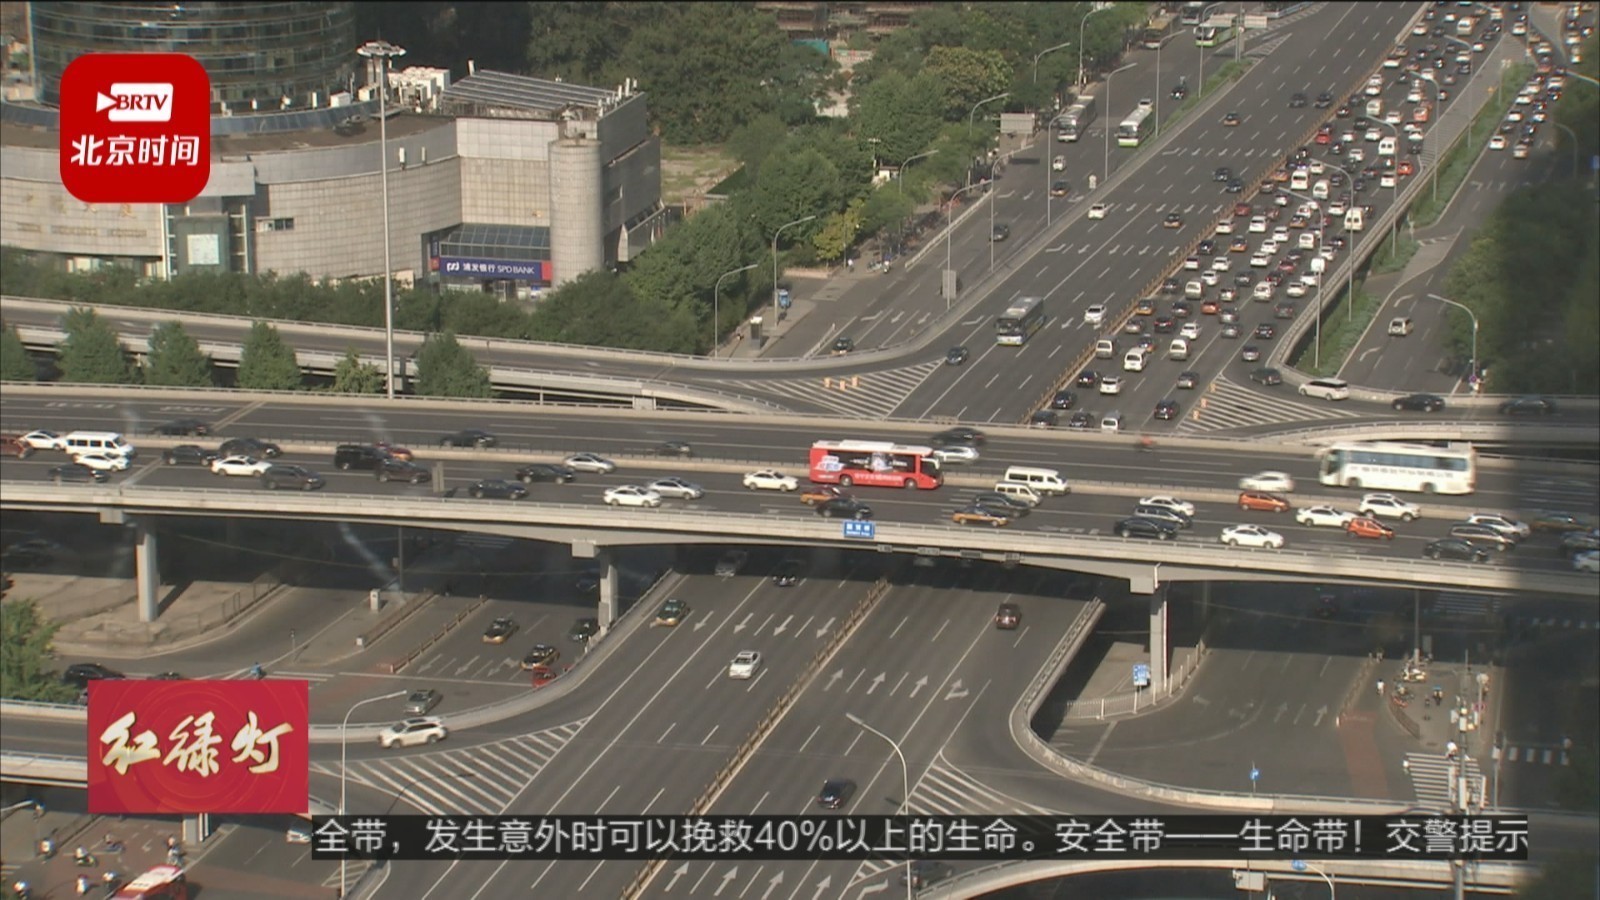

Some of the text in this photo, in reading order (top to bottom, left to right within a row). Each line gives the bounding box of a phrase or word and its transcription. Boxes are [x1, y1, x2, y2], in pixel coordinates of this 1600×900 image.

[463, 262, 535, 275] 浦发银行 SPD BANK
